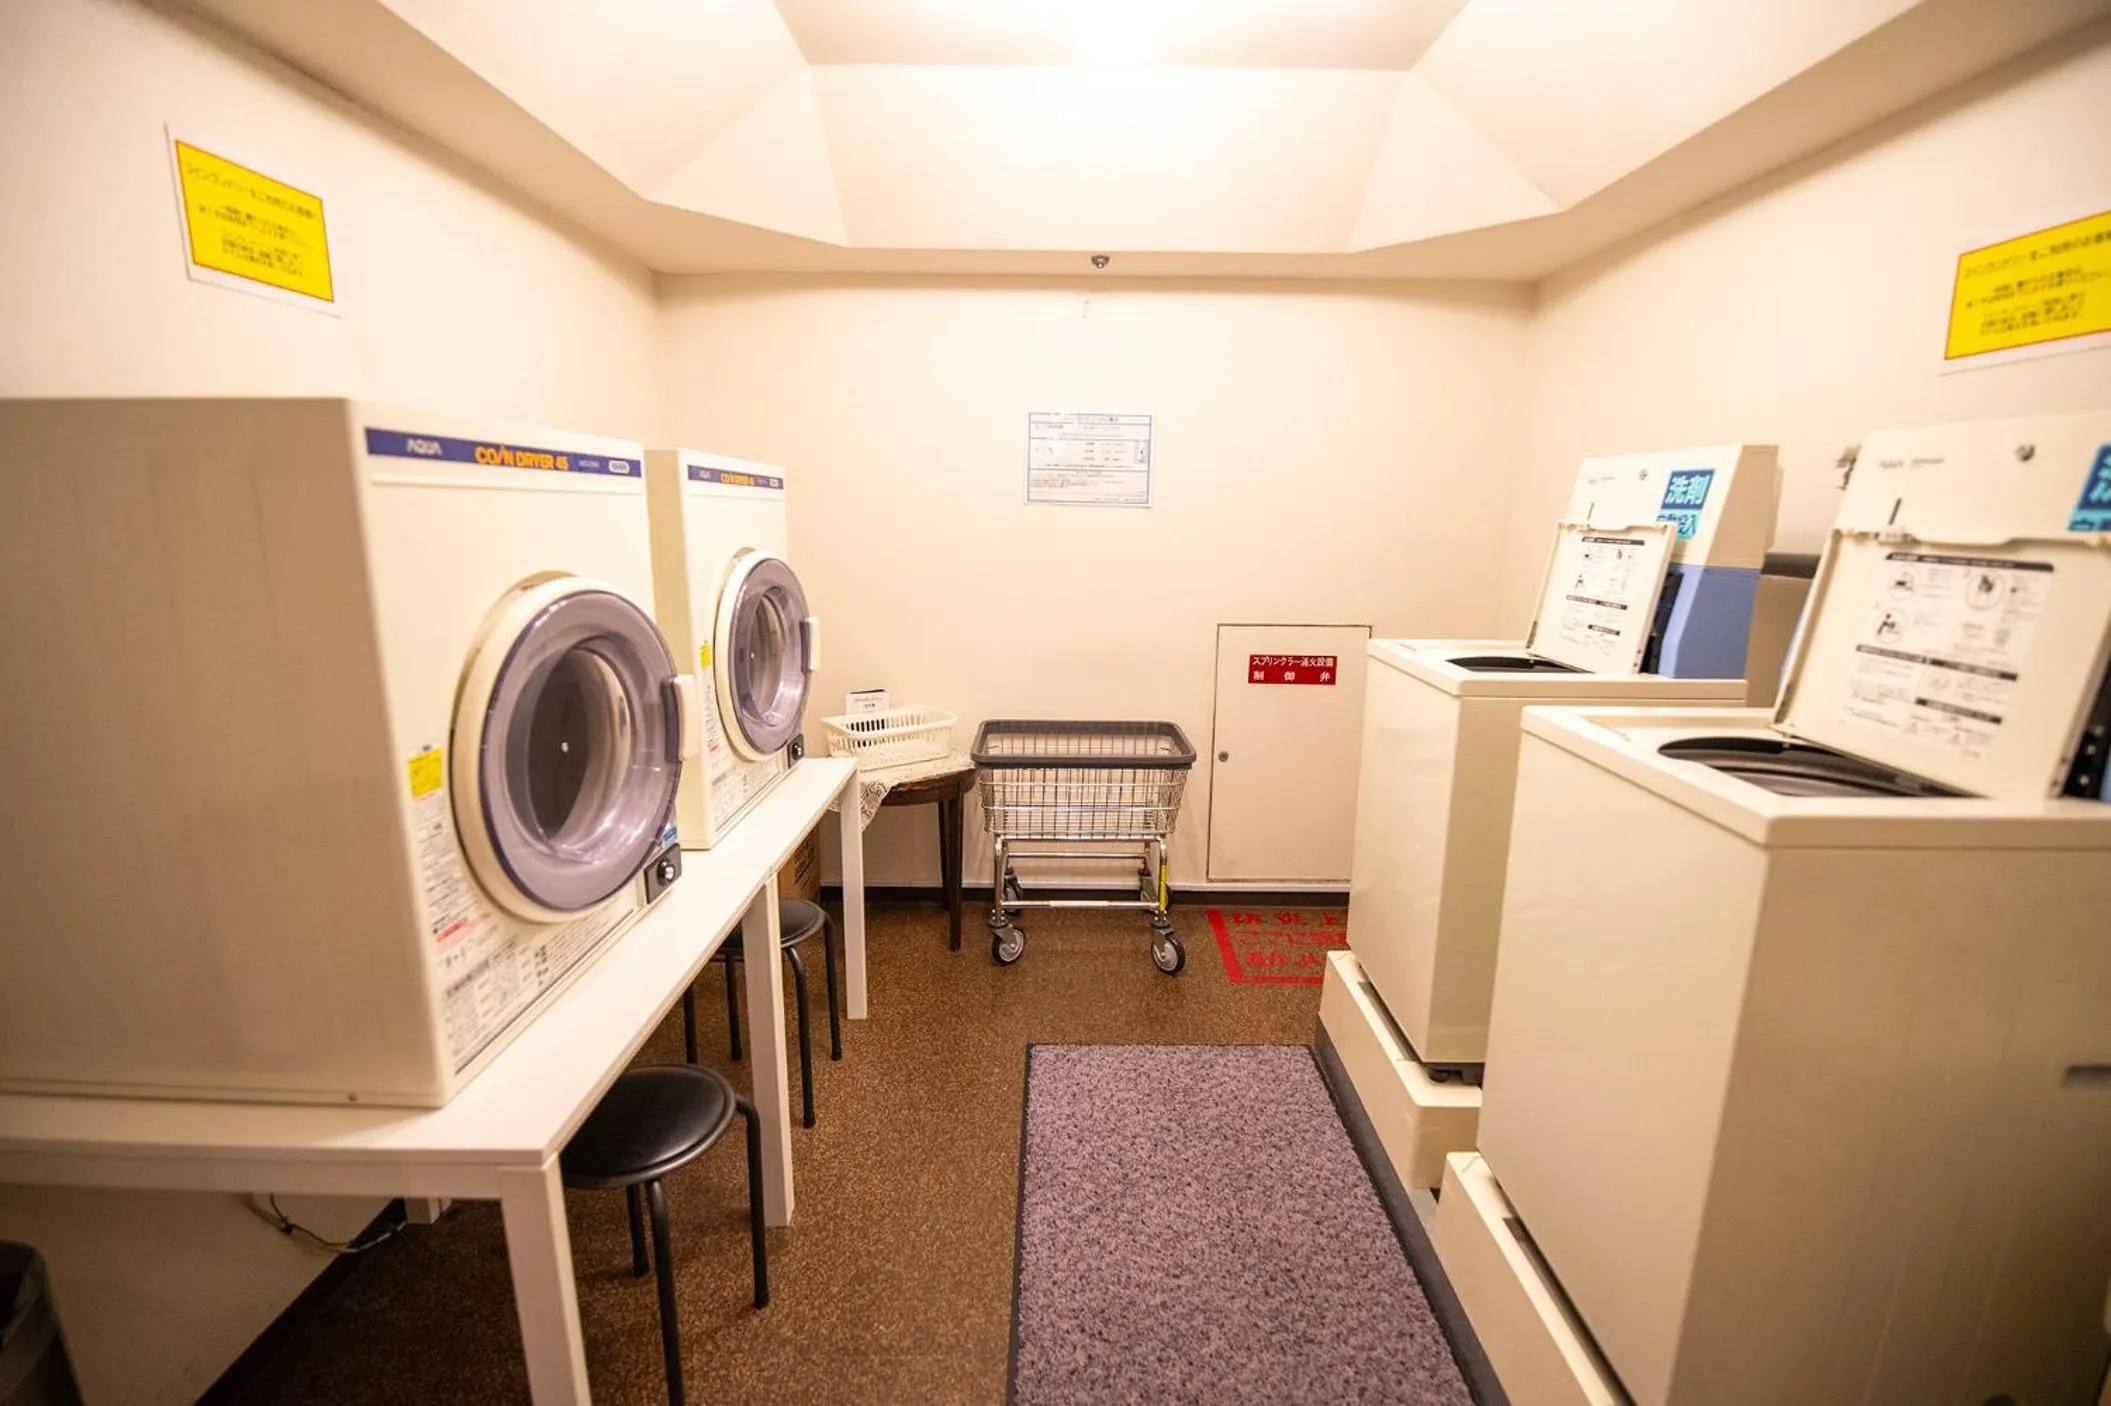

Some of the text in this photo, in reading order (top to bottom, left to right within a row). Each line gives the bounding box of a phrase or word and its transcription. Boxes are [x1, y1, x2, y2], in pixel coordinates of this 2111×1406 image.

[405, 438, 443, 456] AQUA
[516, 451, 555, 469] DRYER
[1665, 475, 1711, 505] 洗剤
[1252, 656, 1335, 668] スプリンクラー消火設備
